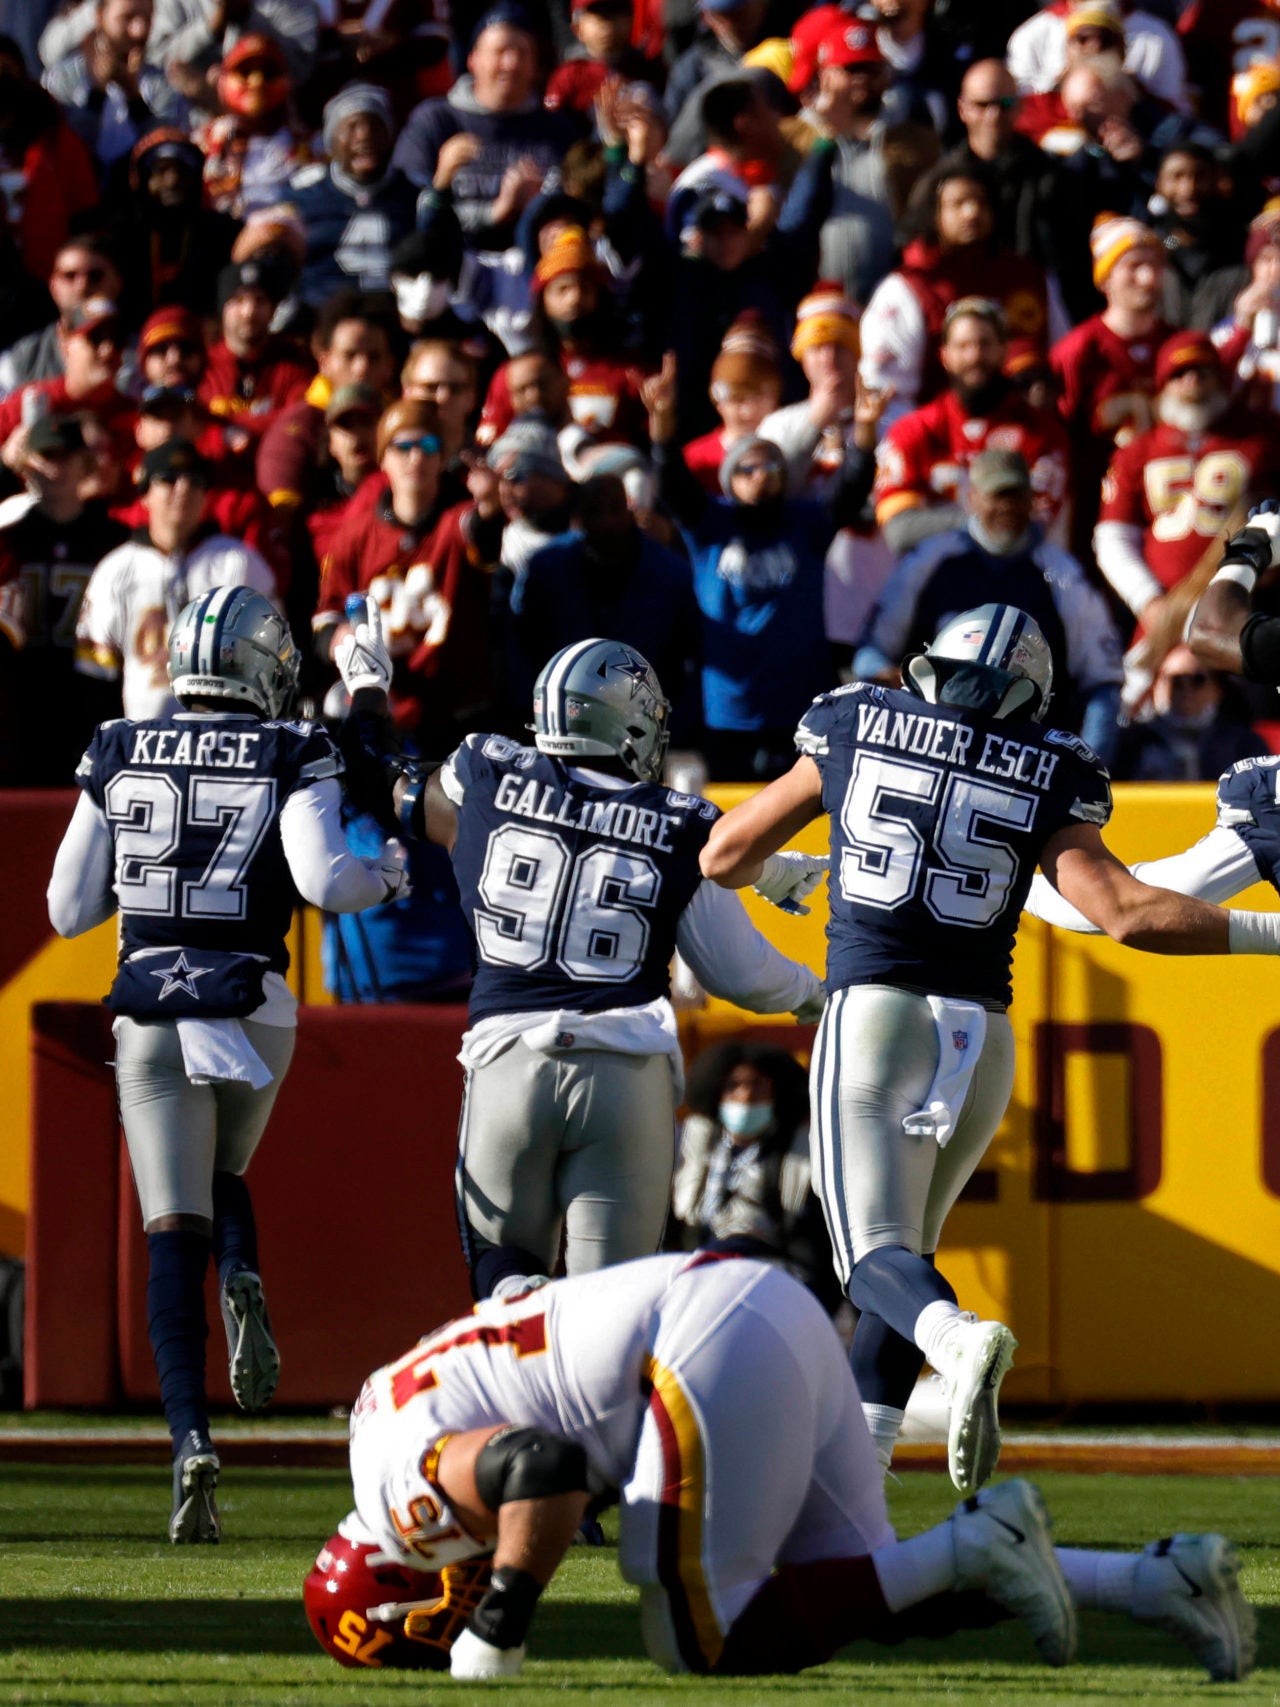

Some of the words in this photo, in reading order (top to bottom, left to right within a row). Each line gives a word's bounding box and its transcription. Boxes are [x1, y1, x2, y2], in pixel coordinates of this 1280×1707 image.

[333, 212, 402, 292] 4
[1143, 451, 1250, 541] 59
[130, 730, 260, 769] KEARSE
[856, 704, 974, 766] VANDER
[976, 733, 1060, 790] ESCH
[105, 771, 276, 920] 27
[494, 774, 682, 853] GALLIMORE
[840, 749, 1039, 928] 55
[474, 823, 661, 983] 96
[333, 1608, 394, 1668] 75
